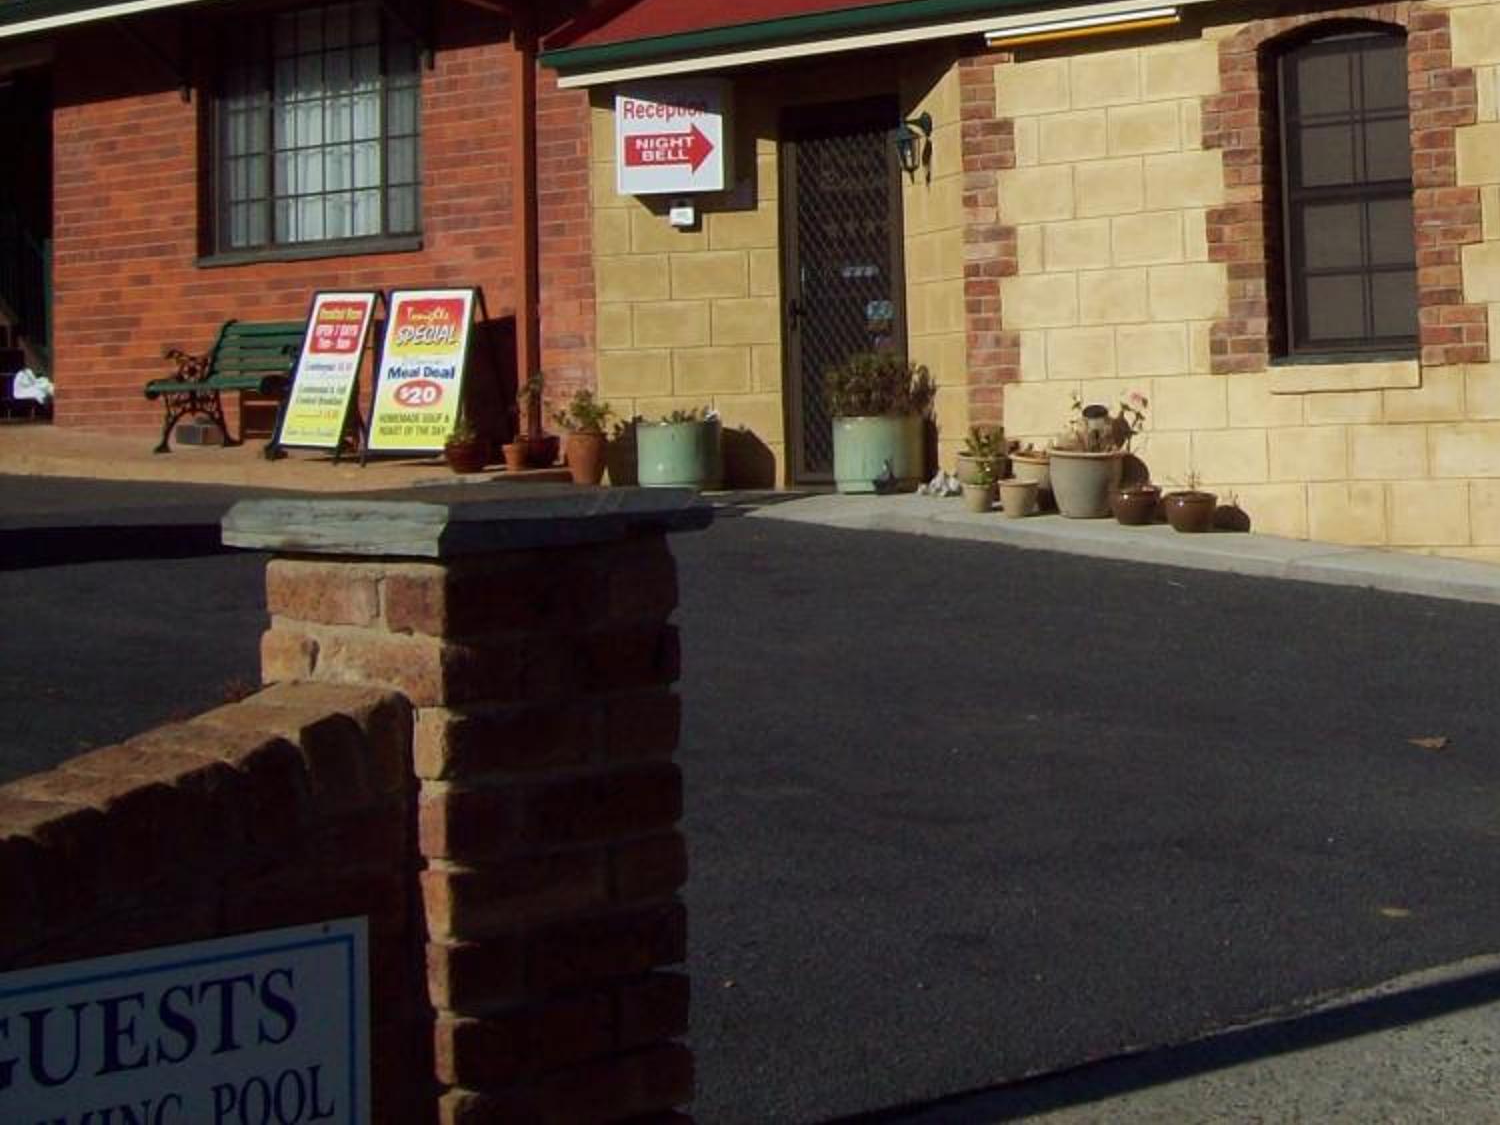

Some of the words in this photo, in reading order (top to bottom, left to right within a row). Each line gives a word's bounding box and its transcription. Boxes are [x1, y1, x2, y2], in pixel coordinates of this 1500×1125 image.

[635, 136, 696, 150] NIGHT
[641, 149, 689, 162] BELL
[397, 325, 459, 346] SPECIAL
[388, 365, 420, 380] Meal
[423, 365, 455, 380] Deal
[400, 386, 437, 404] $20
[211, 1065, 335, 1125] POOL
